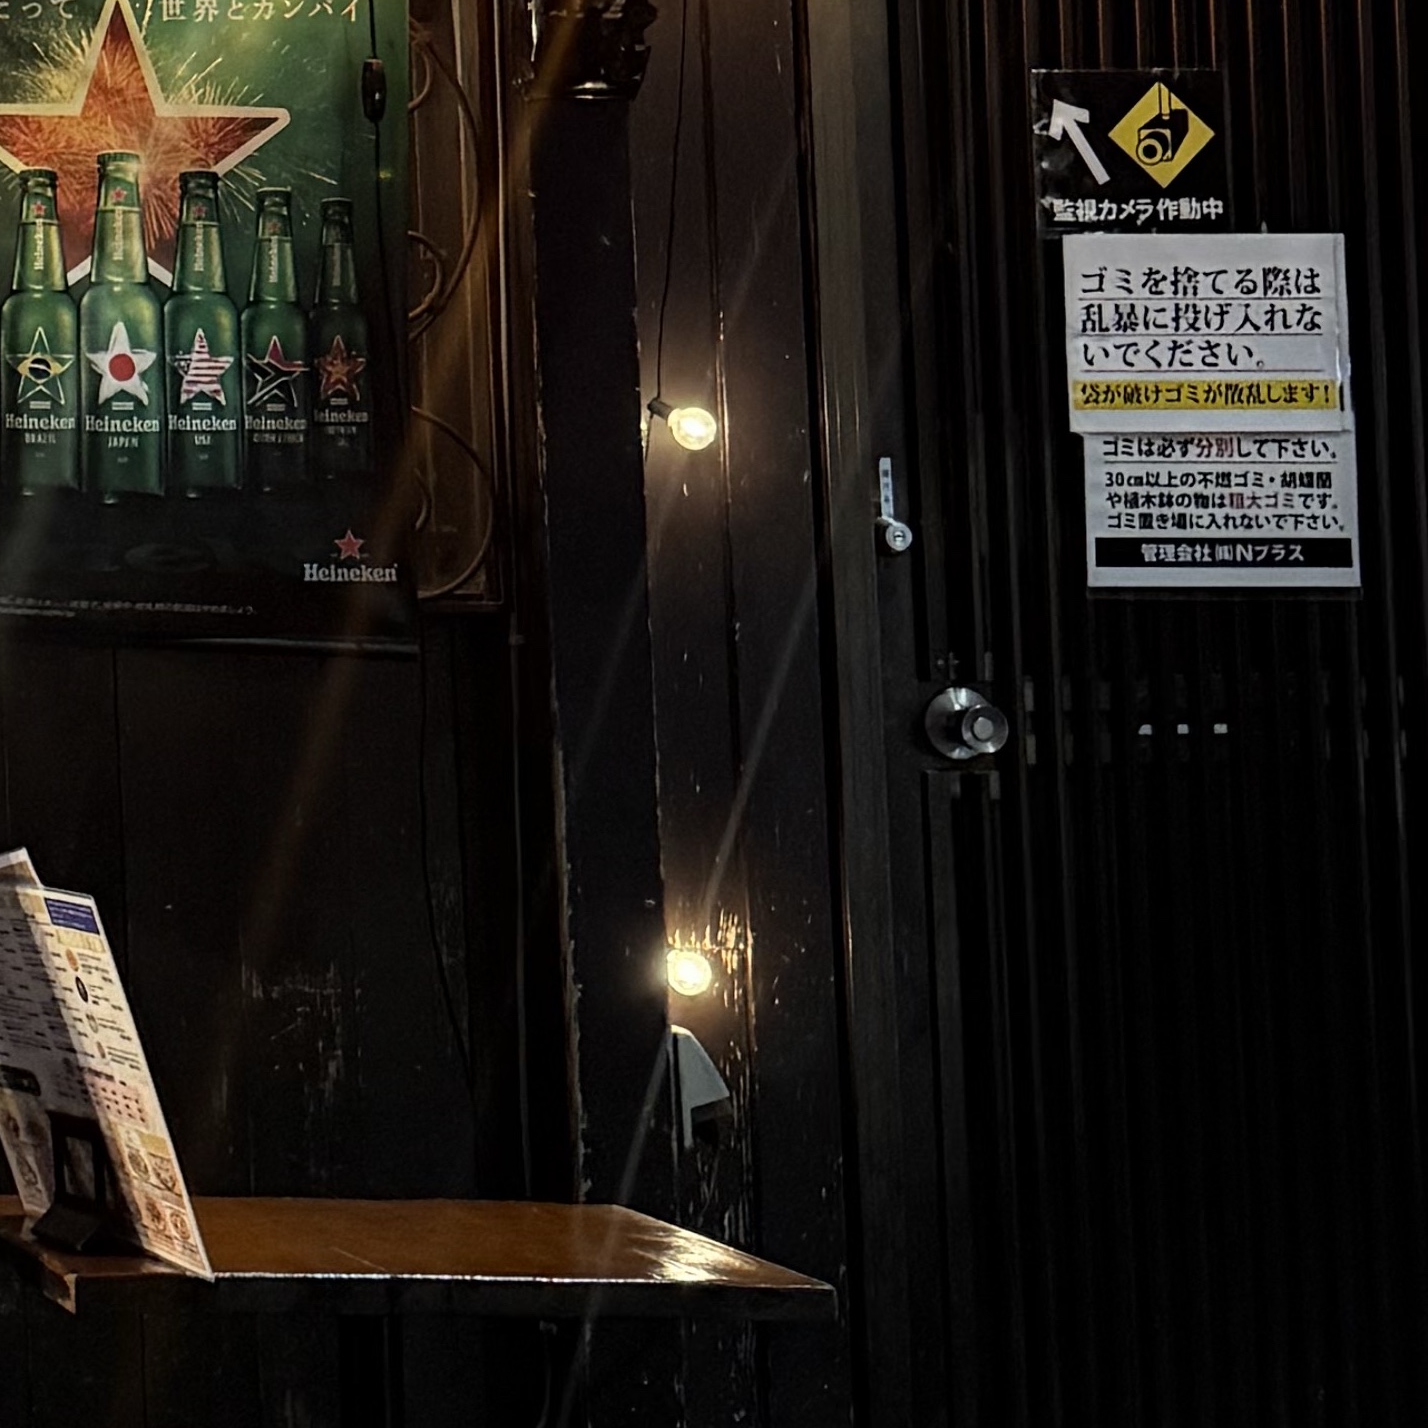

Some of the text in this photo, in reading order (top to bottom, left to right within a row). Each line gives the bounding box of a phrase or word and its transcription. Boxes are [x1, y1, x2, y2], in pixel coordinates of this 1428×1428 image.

[1052, 197, 1224, 222] 監視カメラ作動中
[1080, 265, 1322, 297] ゴミを捨てる際は
[1080, 303, 1323, 333] 乱暴に投げ入れな
[1081, 339, 1266, 369] いでください。
[5, 413, 76, 431] Heineken
[85, 414, 160, 432] Heineken
[168, 414, 237, 431] Heineken
[304, 563, 398, 583] Heineken
